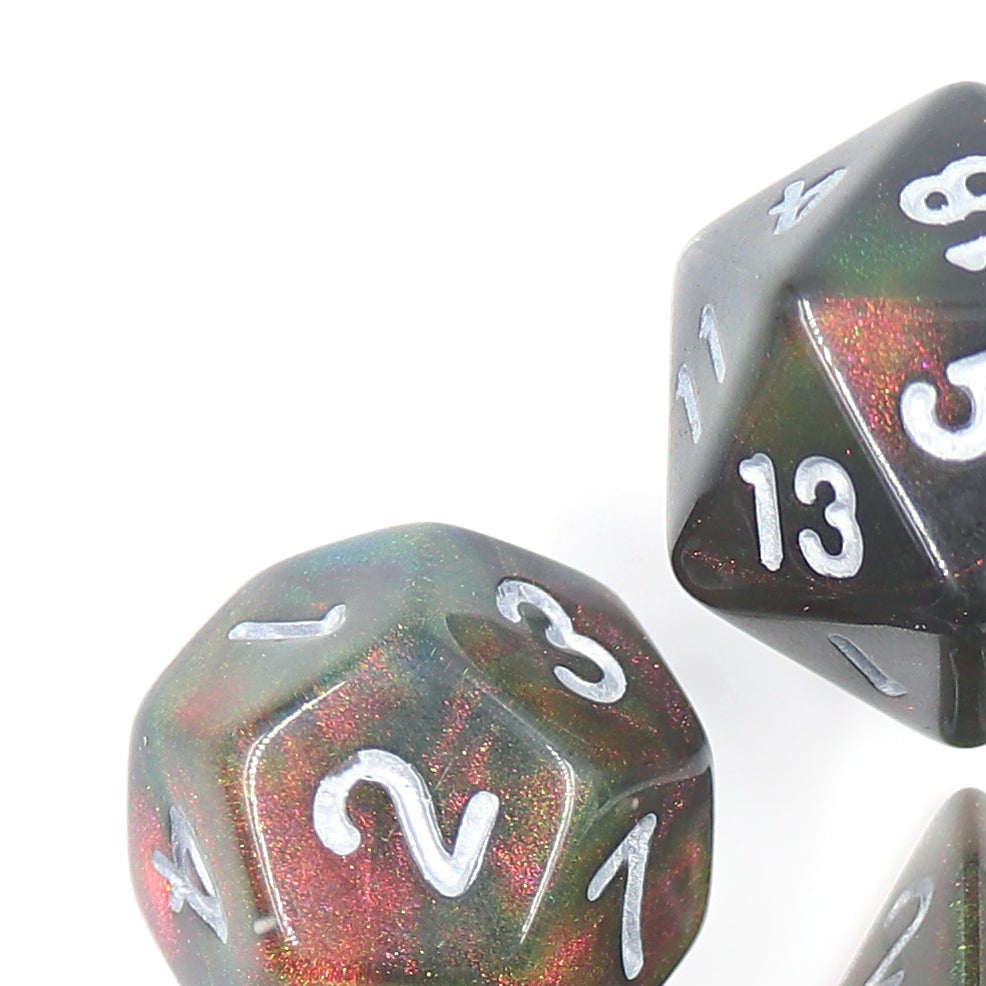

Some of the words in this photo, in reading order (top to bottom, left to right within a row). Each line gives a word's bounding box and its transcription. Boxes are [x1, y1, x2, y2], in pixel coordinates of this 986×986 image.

[768, 166, 848, 235] 4
[674, 304, 726, 443] 11
[739, 452, 864, 579] 13
[228, 603, 348, 640] 1
[495, 578, 627, 703] 3
[152, 804, 229, 944] 4
[312, 748, 499, 897] 2
